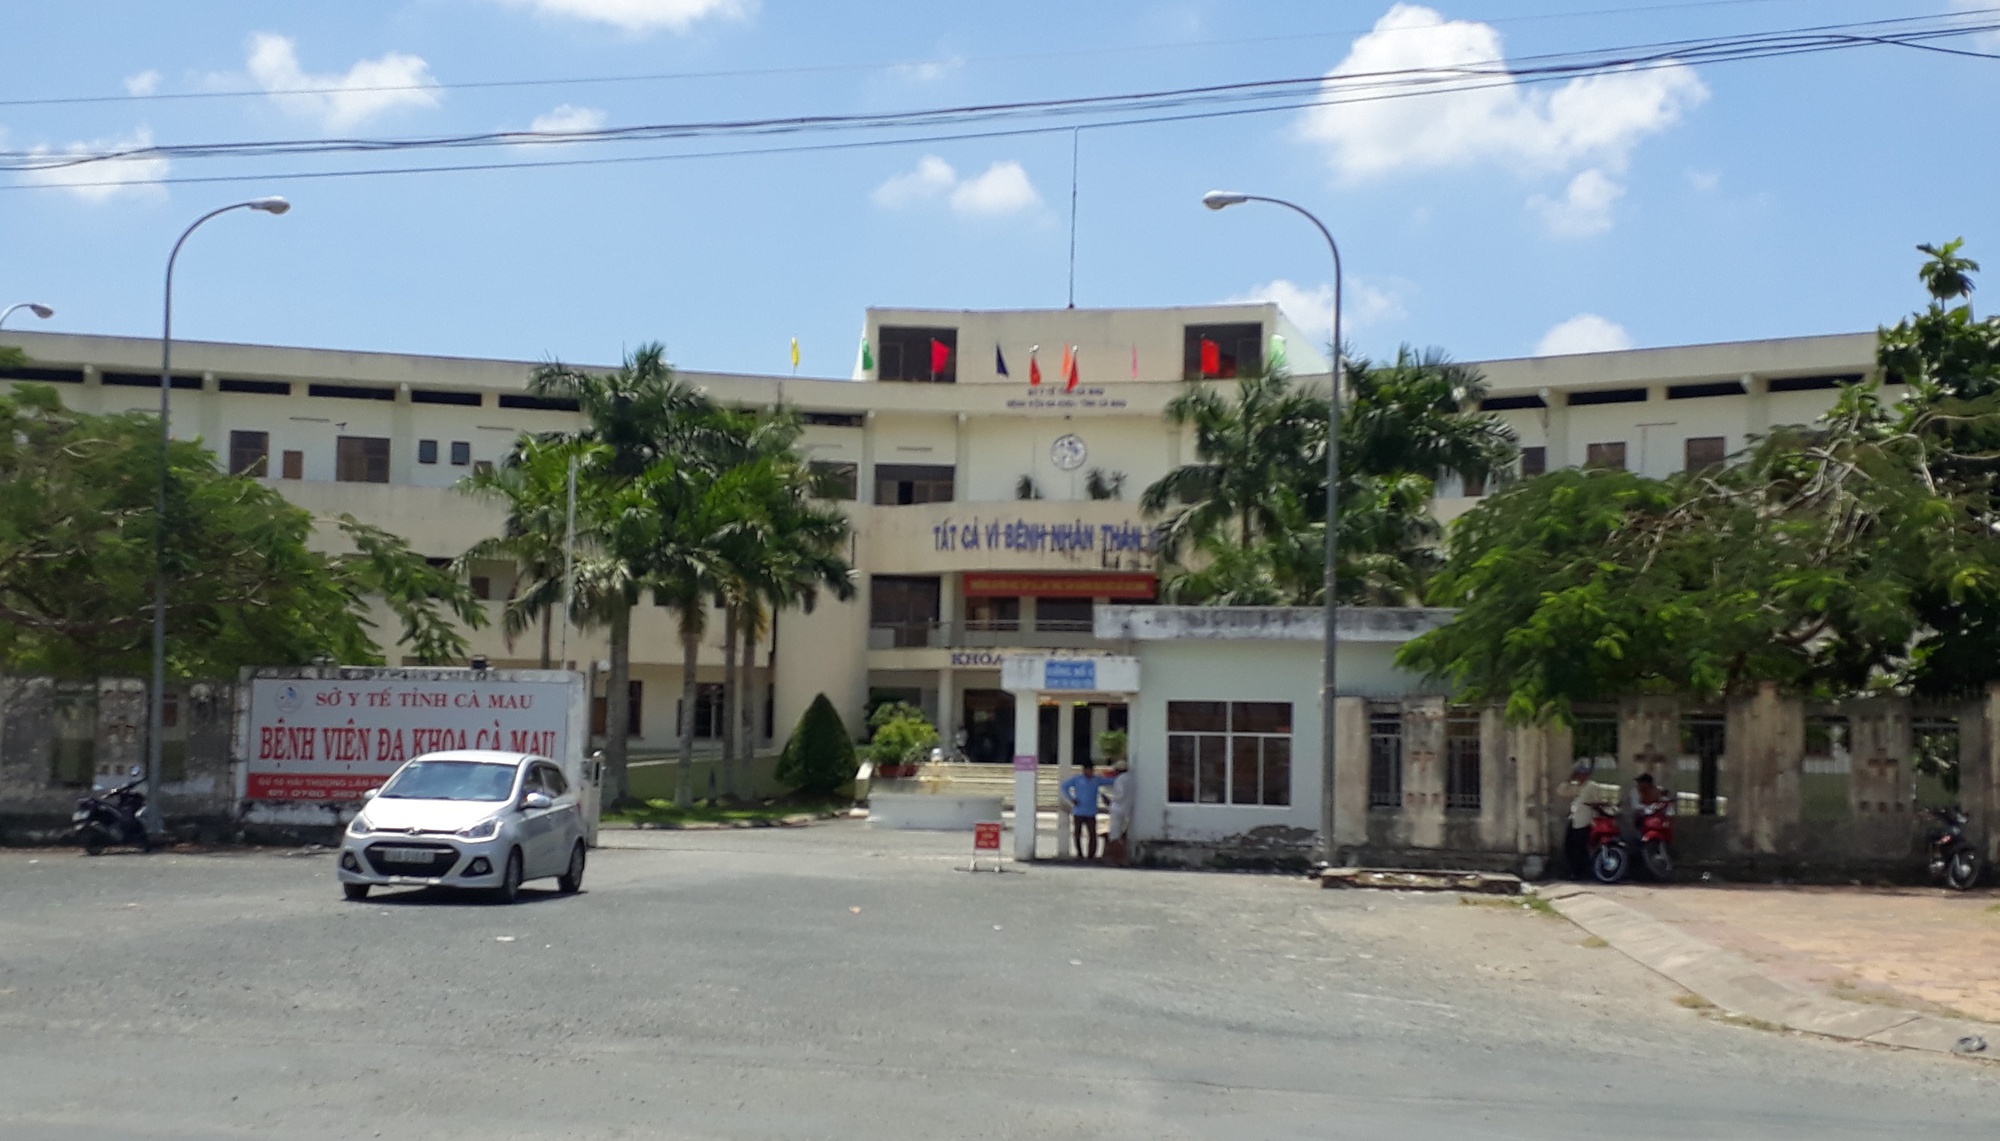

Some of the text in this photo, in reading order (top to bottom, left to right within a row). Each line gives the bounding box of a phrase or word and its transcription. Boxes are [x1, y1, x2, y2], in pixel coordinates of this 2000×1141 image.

[316, 686, 533, 709] SỞ Y TẾ TỈNH CÀ MAU
[259, 717, 316, 768] BỆNH
[322, 718, 372, 769] VIỆN
[377, 727, 406, 762] ĐA
[412, 728, 467, 757] KHOA
[511, 730, 556, 757] MAU
